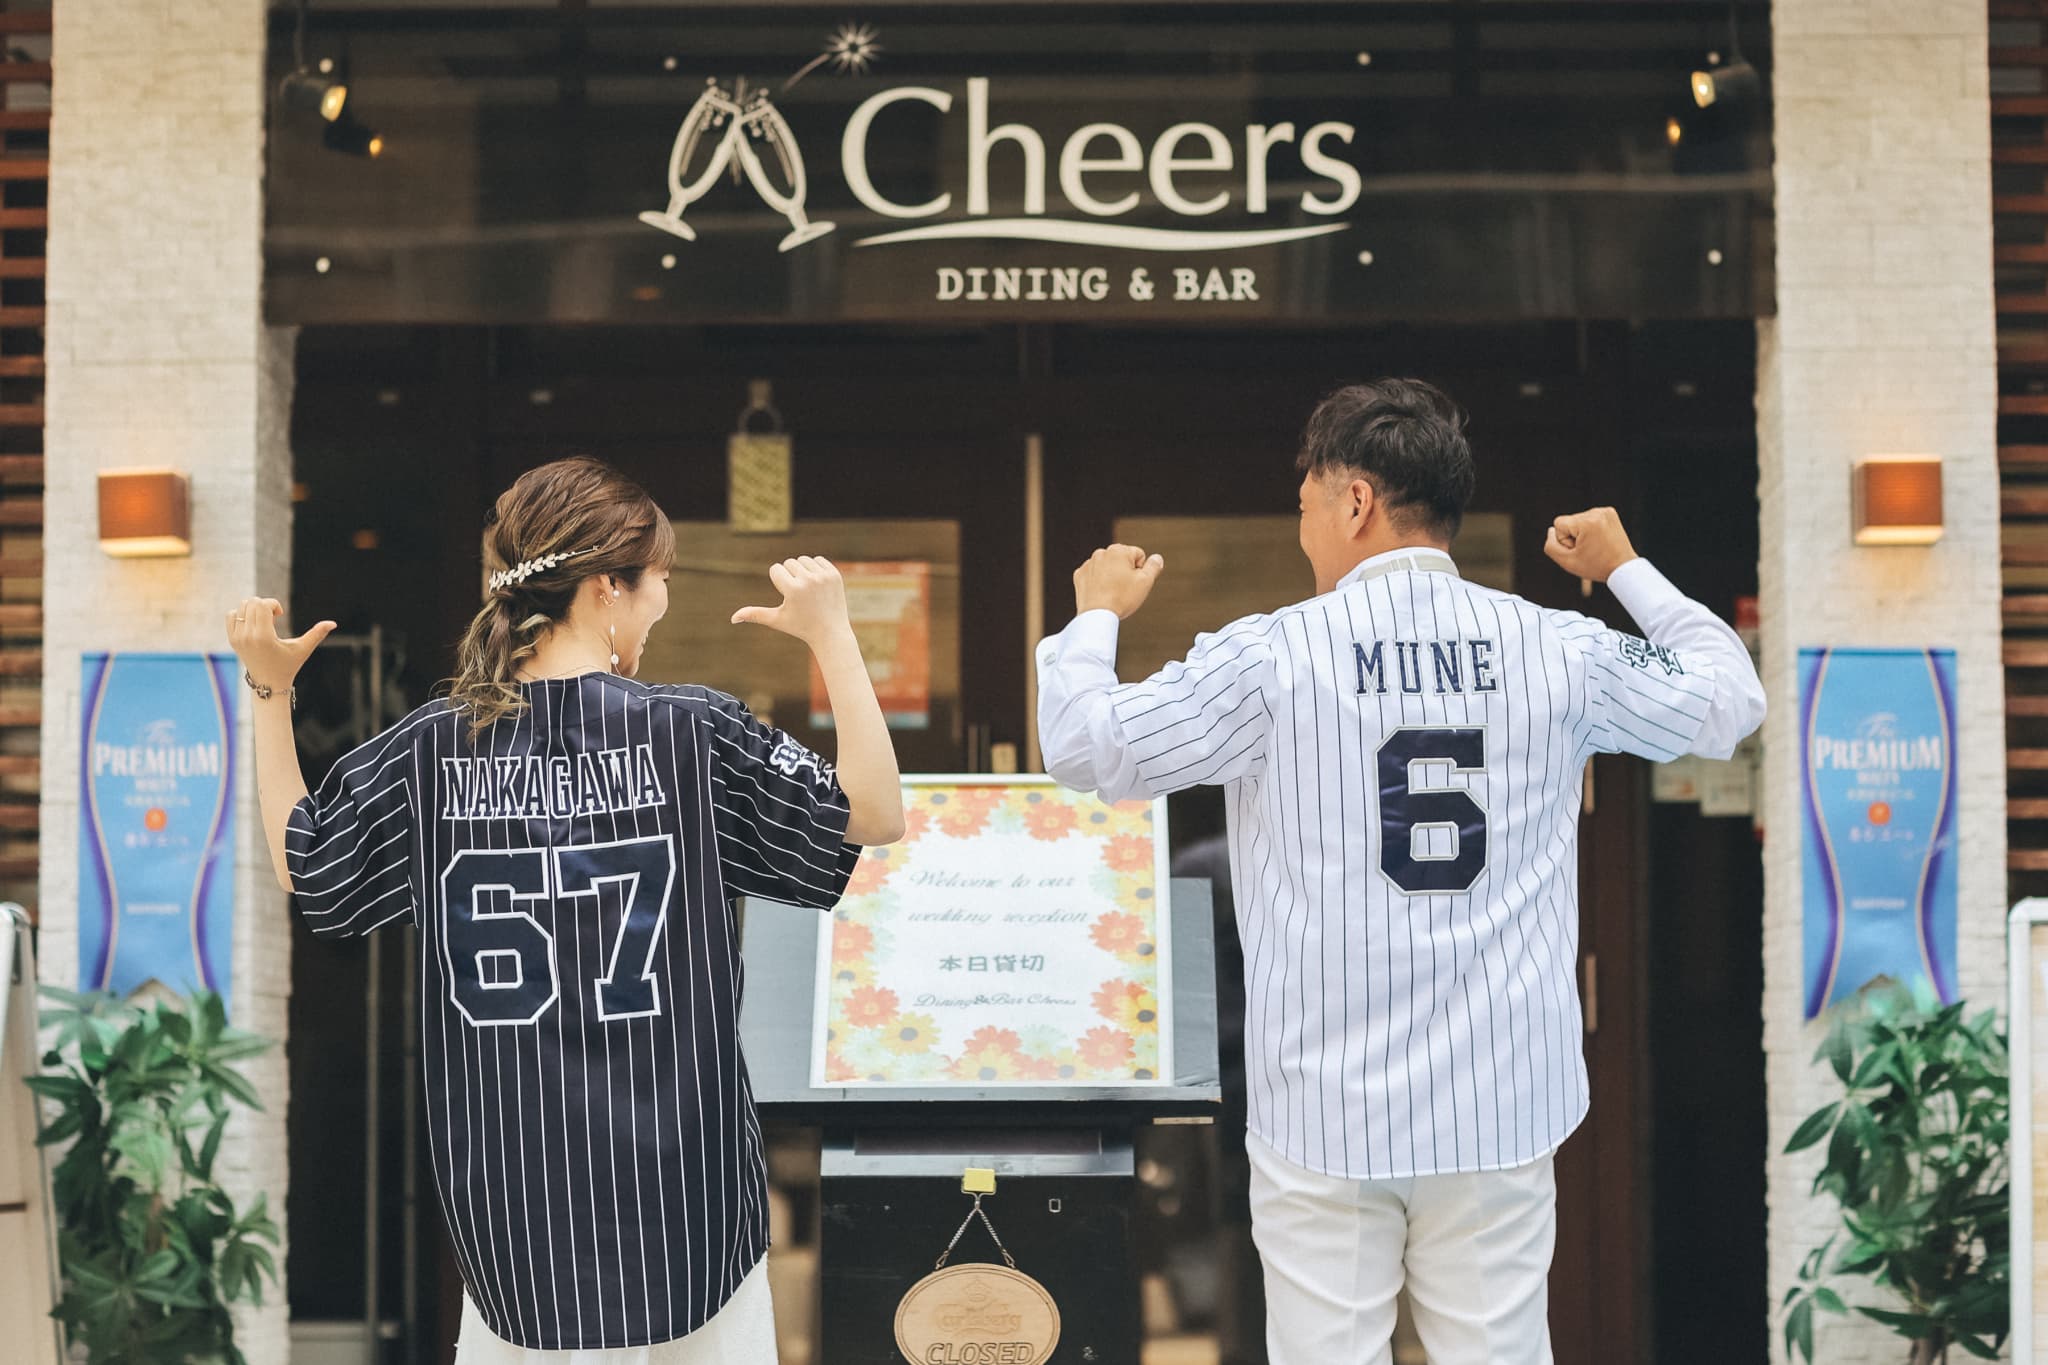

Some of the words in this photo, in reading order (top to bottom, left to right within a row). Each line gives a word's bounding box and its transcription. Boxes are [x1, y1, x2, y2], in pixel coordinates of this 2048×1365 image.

[841, 77, 1362, 218] Cheers
[936, 267, 1109, 302] DINING
[1129, 268, 1155, 301] &
[1173, 268, 1260, 302] BAR
[1352, 639, 1499, 696] MUNE
[94, 742, 219, 777] PREMIUM
[1815, 734, 1941, 770] PREMIUM
[441, 744, 665, 820] NAKAGAWA
[1375, 724, 1490, 897] 6
[909, 870, 1002, 888] Welcome
[1010, 873, 1032, 888] to
[1037, 876, 1076, 888] our
[440, 834, 677, 1026] 67
[907, 906, 993, 924] wedding
[1001, 907, 1088, 924] reception
[939, 953, 1046, 973] 本日貸切
[925, 1341, 1035, 1365] CLOSED
